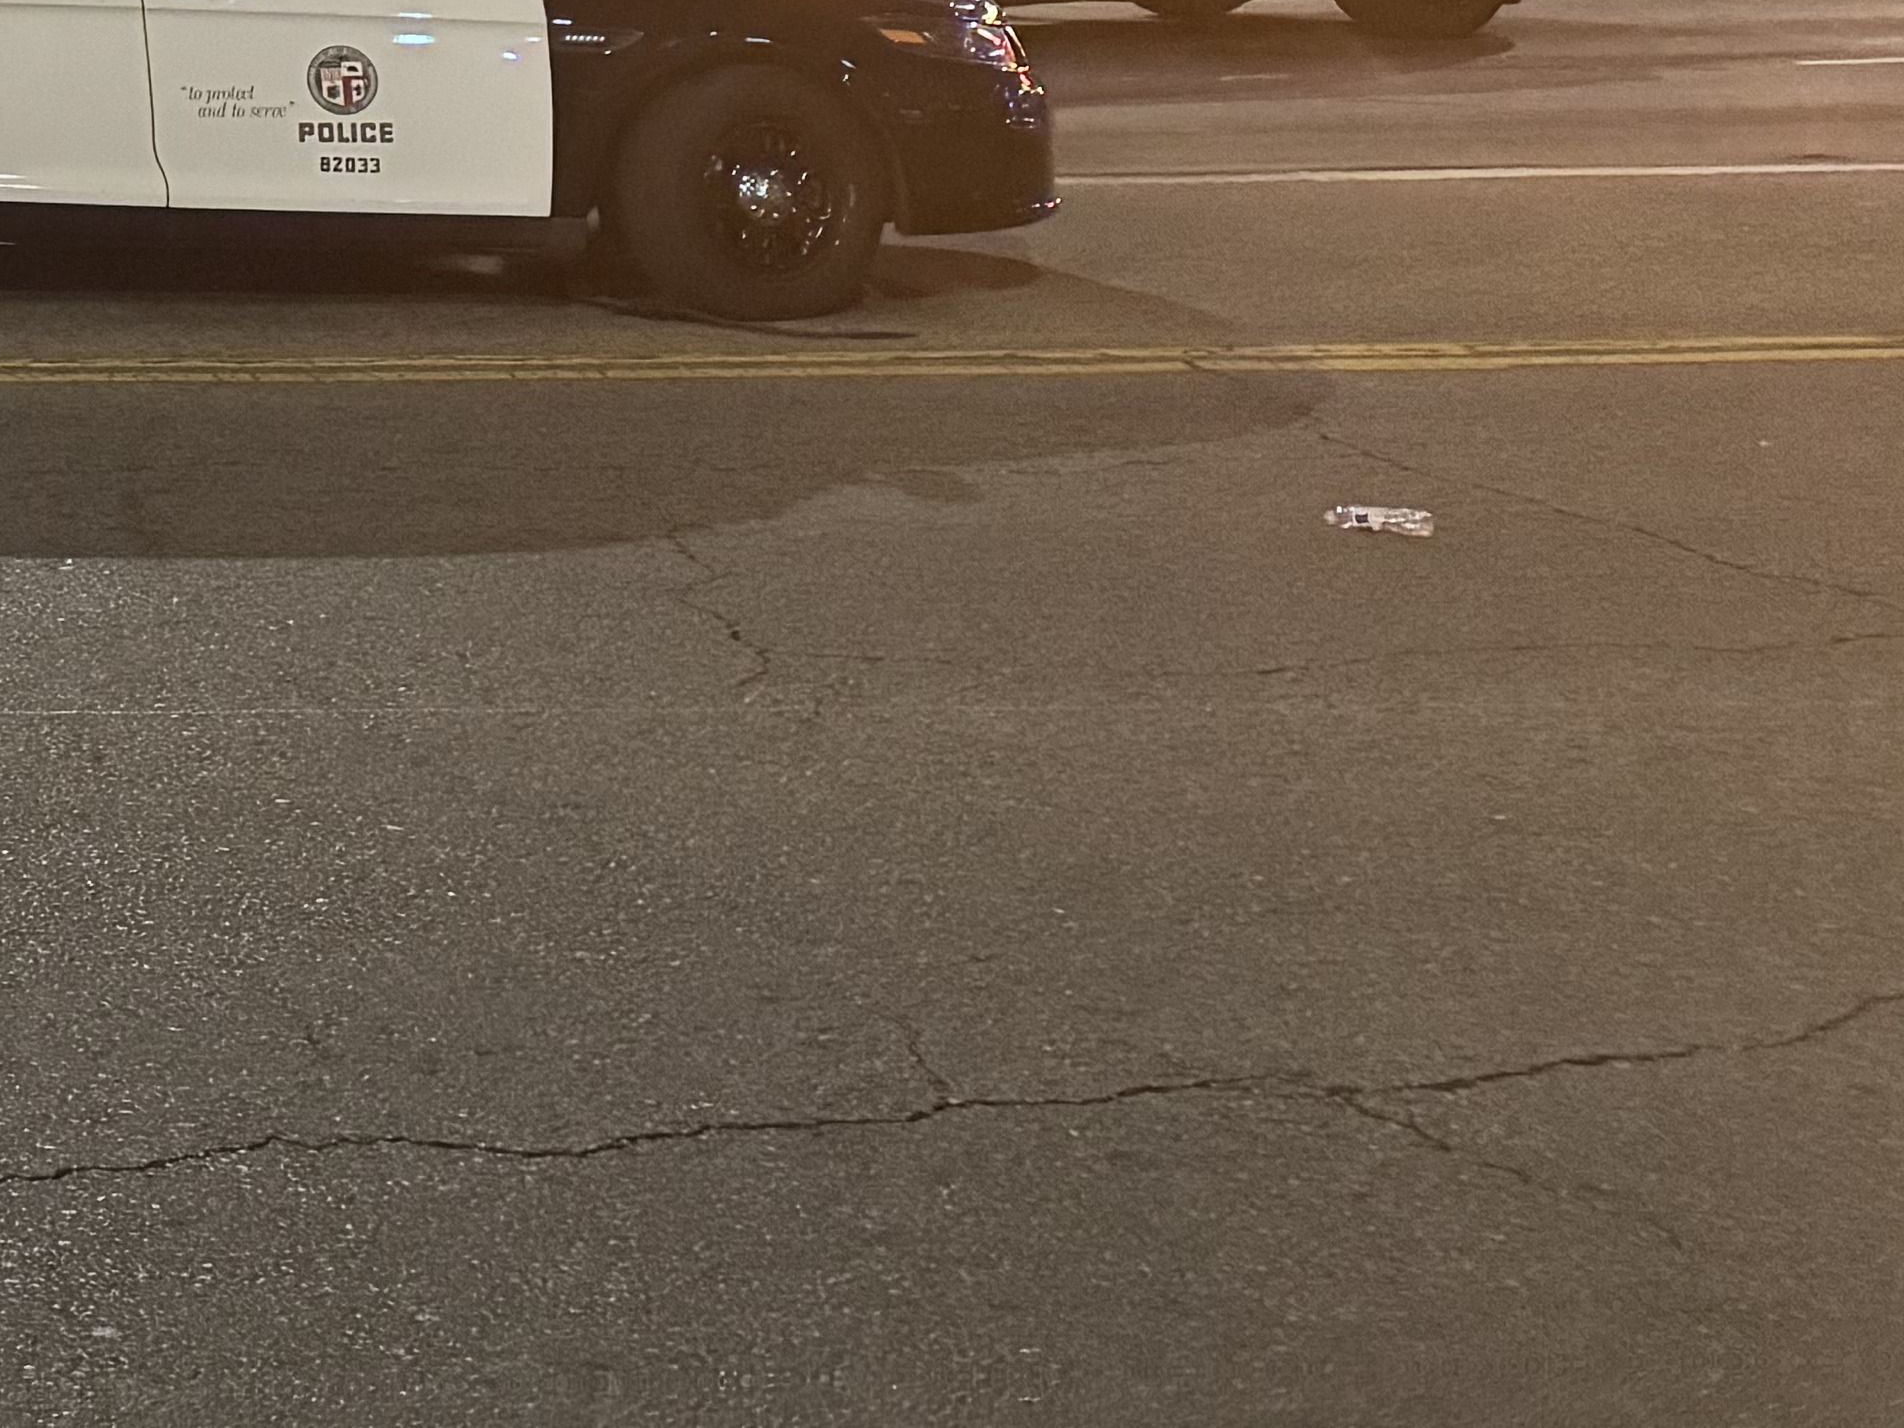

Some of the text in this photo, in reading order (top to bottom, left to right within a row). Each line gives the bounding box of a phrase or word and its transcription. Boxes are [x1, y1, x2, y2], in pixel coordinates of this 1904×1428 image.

[206, 85, 255, 104] protect
[198, 102, 227, 118] and
[231, 103, 245, 118] to
[298, 122, 394, 143] POLICE
[320, 156, 381, 173] 82033
